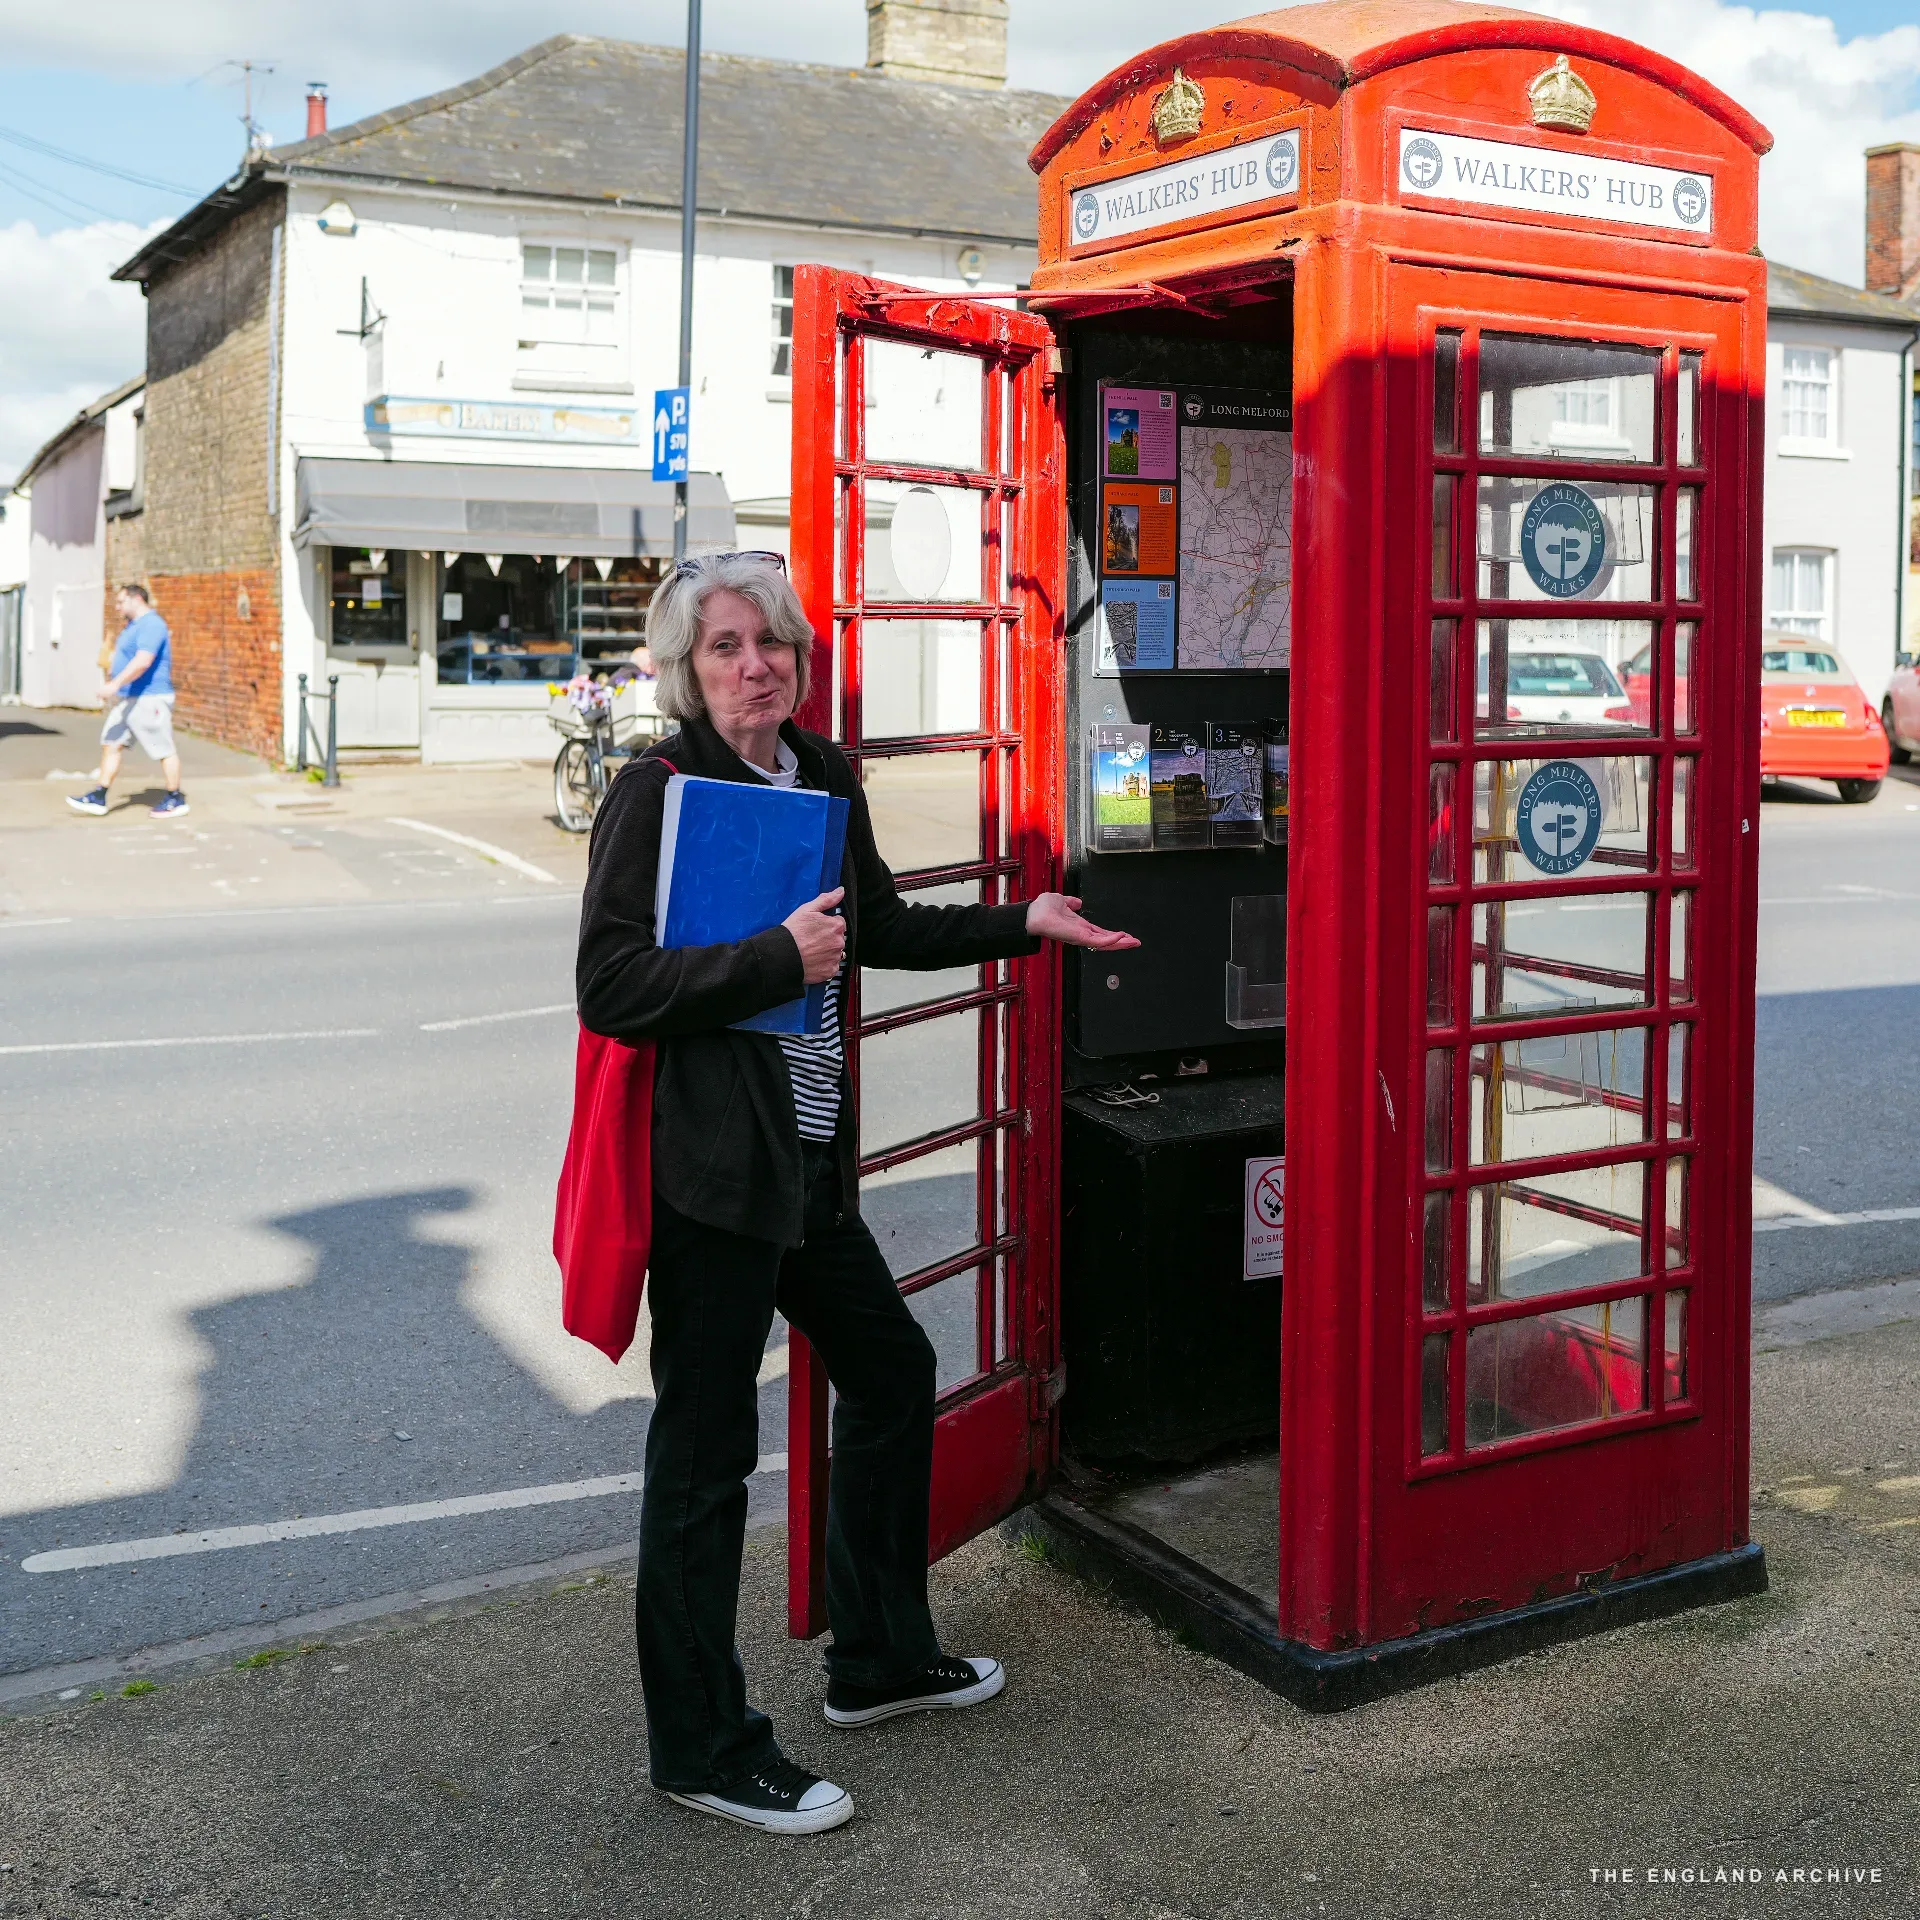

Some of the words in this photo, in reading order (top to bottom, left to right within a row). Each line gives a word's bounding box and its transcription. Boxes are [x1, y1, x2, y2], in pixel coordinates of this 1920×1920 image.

[1105, 173, 1205, 222] WALKERS'
[1211, 160, 1258, 196] HUB
[1453, 156, 1597, 200] WALKERS'
[1606, 178, 1663, 209] HUB
[671, 395, 686, 425] P
[1211, 404, 1240, 415] LONG
[1241, 406, 1290, 418] MELFORD
[1525, 495, 1549, 540] LONG
[1553, 489, 1602, 544] MELFORD
[1539, 572, 1586, 594] WALKS
[1154, 728, 1167, 742] 2.
[1215, 728, 1227, 742] 3.
[1520, 775, 1545, 820] LONG
[1550, 766, 1598, 818] MELFORD
[1535, 850, 1582, 871] WALKS
[1252, 1236, 1264, 1245] NO
